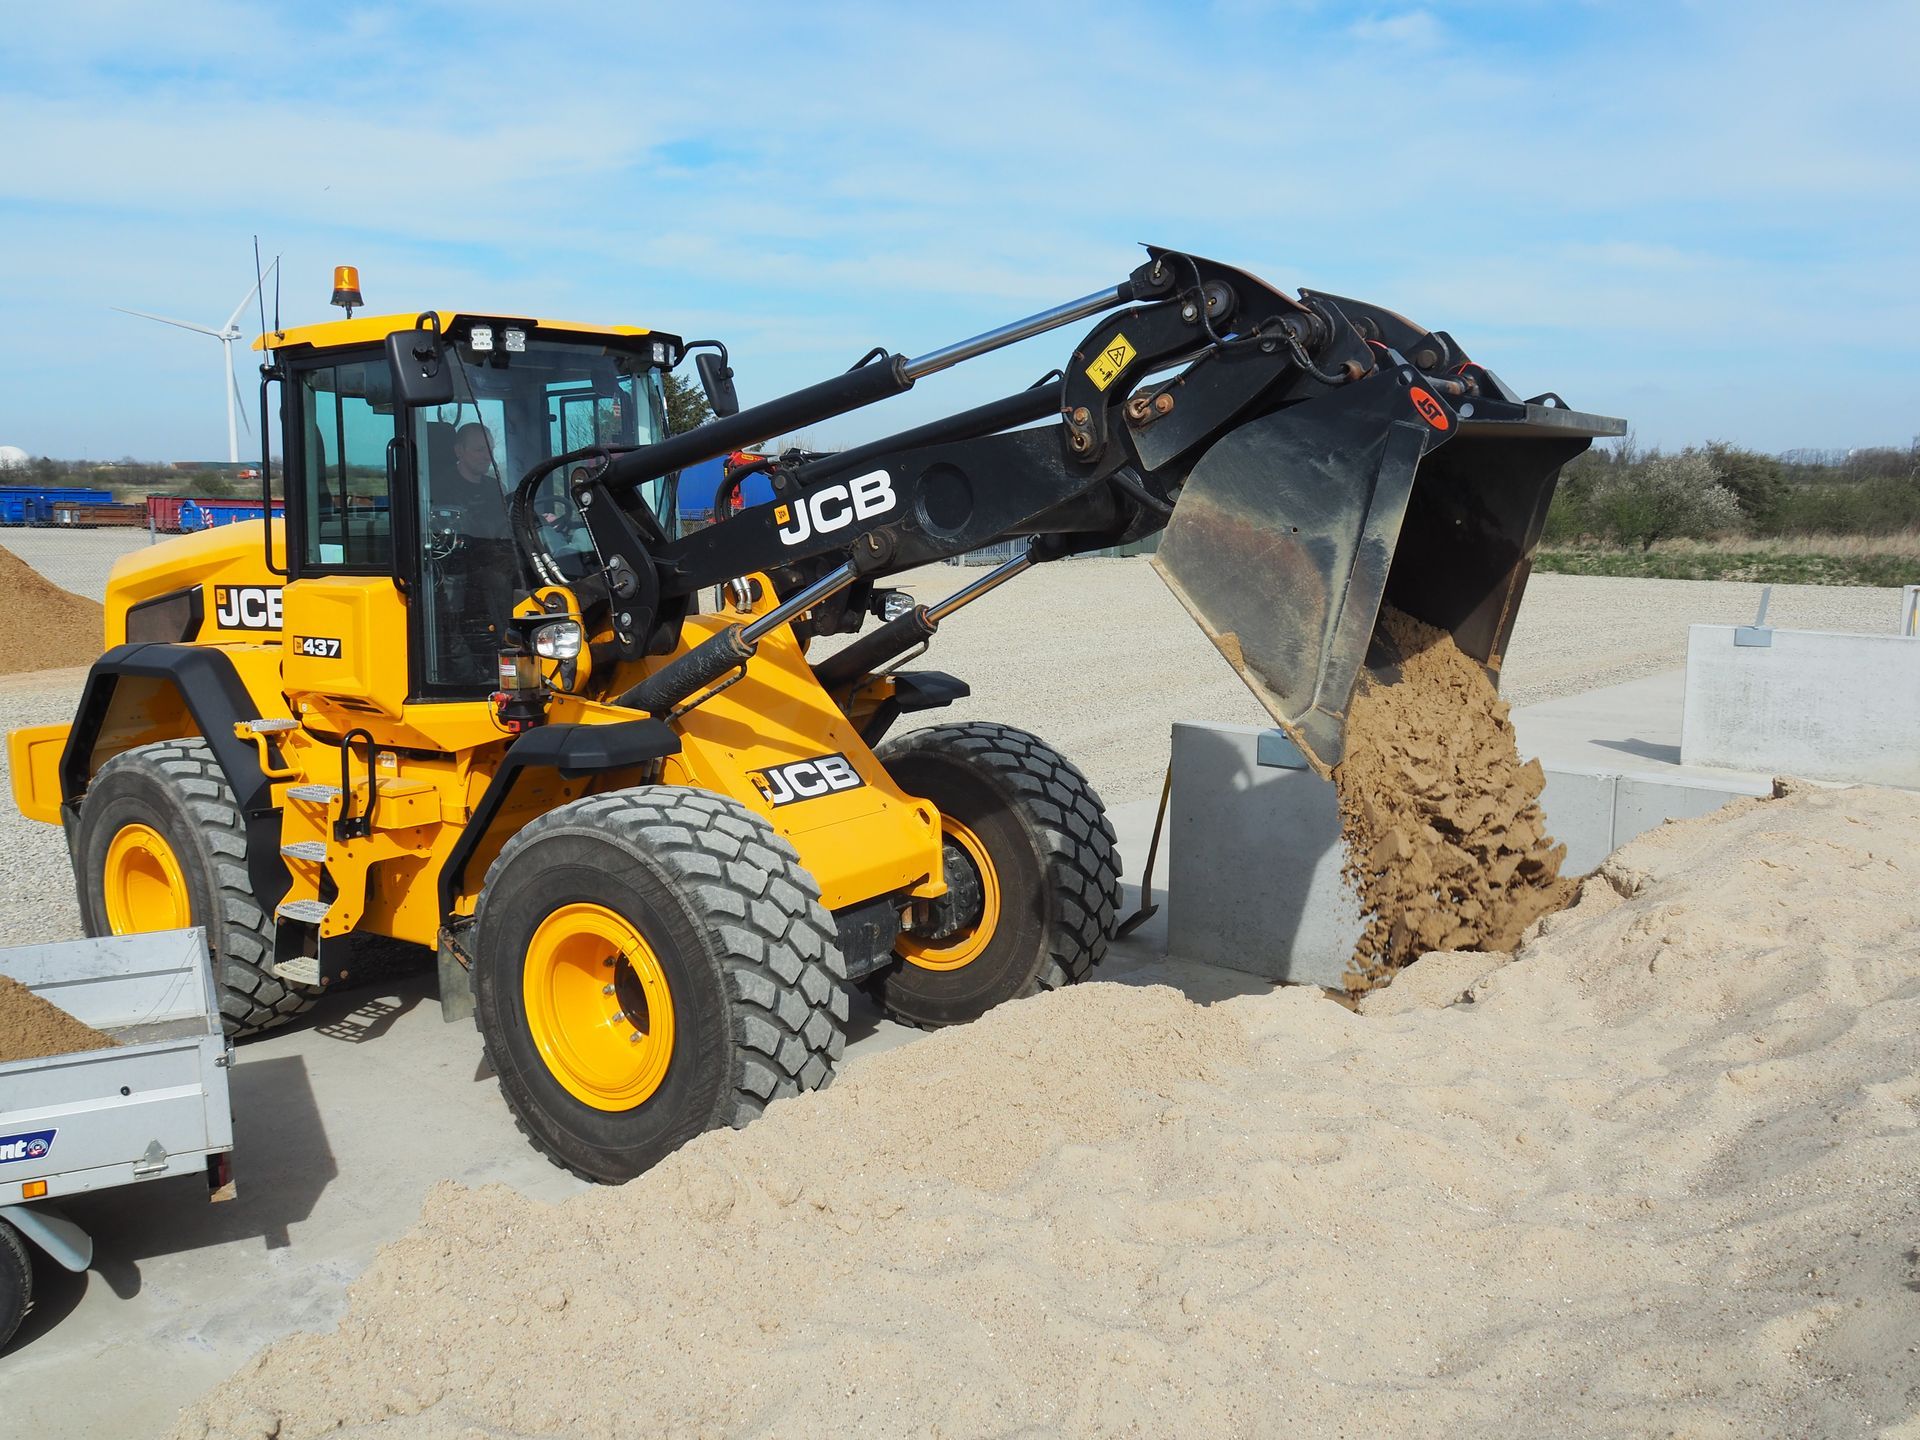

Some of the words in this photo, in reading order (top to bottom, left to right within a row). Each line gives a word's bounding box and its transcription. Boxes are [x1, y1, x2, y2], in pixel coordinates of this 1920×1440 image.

[779, 469, 896, 545] JCB
[303, 639, 340, 656] 437
[763, 756, 860, 804] JCB
